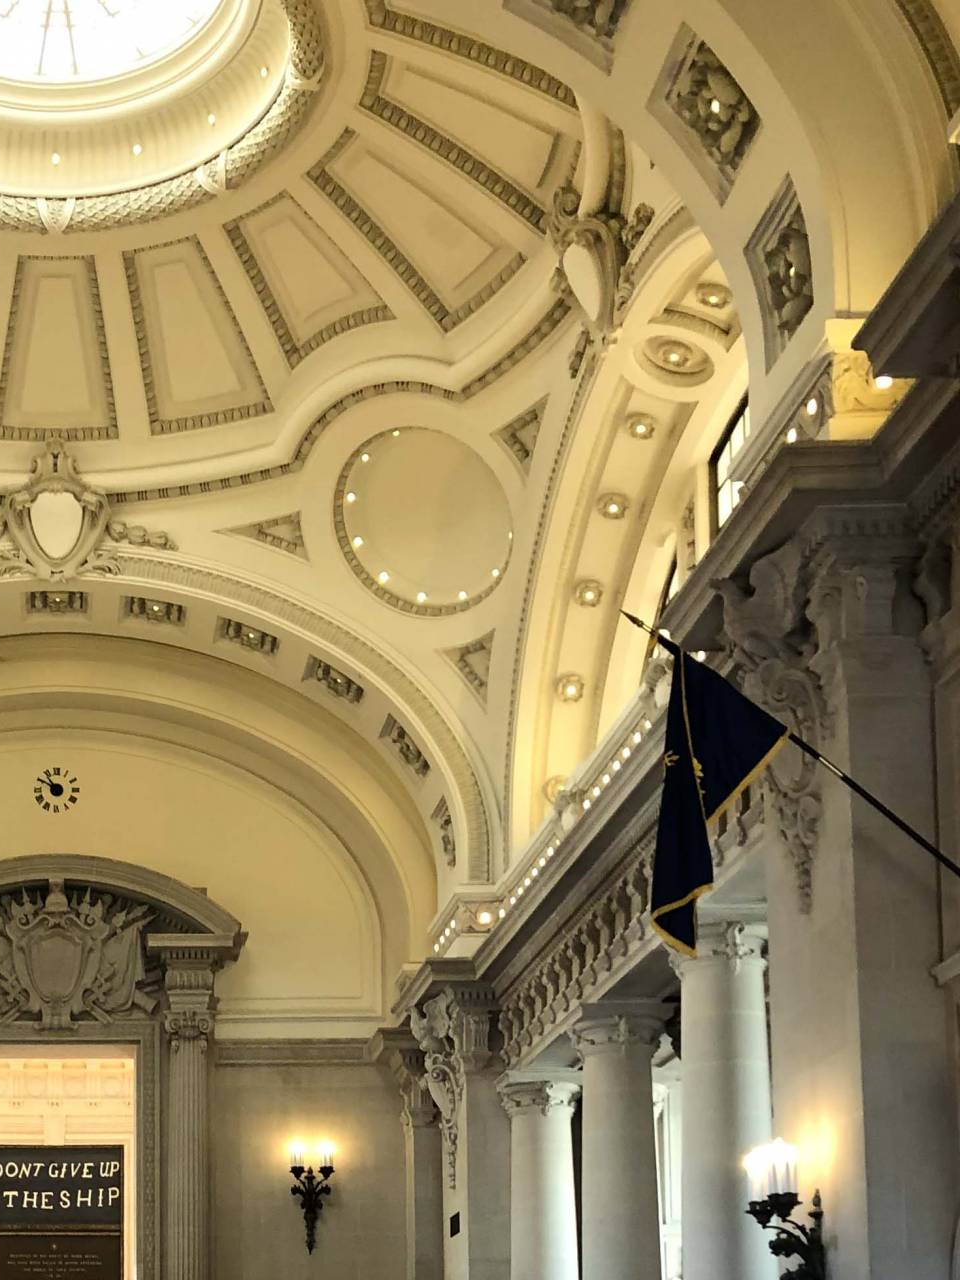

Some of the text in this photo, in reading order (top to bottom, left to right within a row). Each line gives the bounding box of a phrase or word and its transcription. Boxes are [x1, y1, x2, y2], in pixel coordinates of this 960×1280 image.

[48, 1162, 95, 1178] GIVE
[99, 1161, 120, 1178] UP
[3, 1187, 120, 1209] THE SHIP
